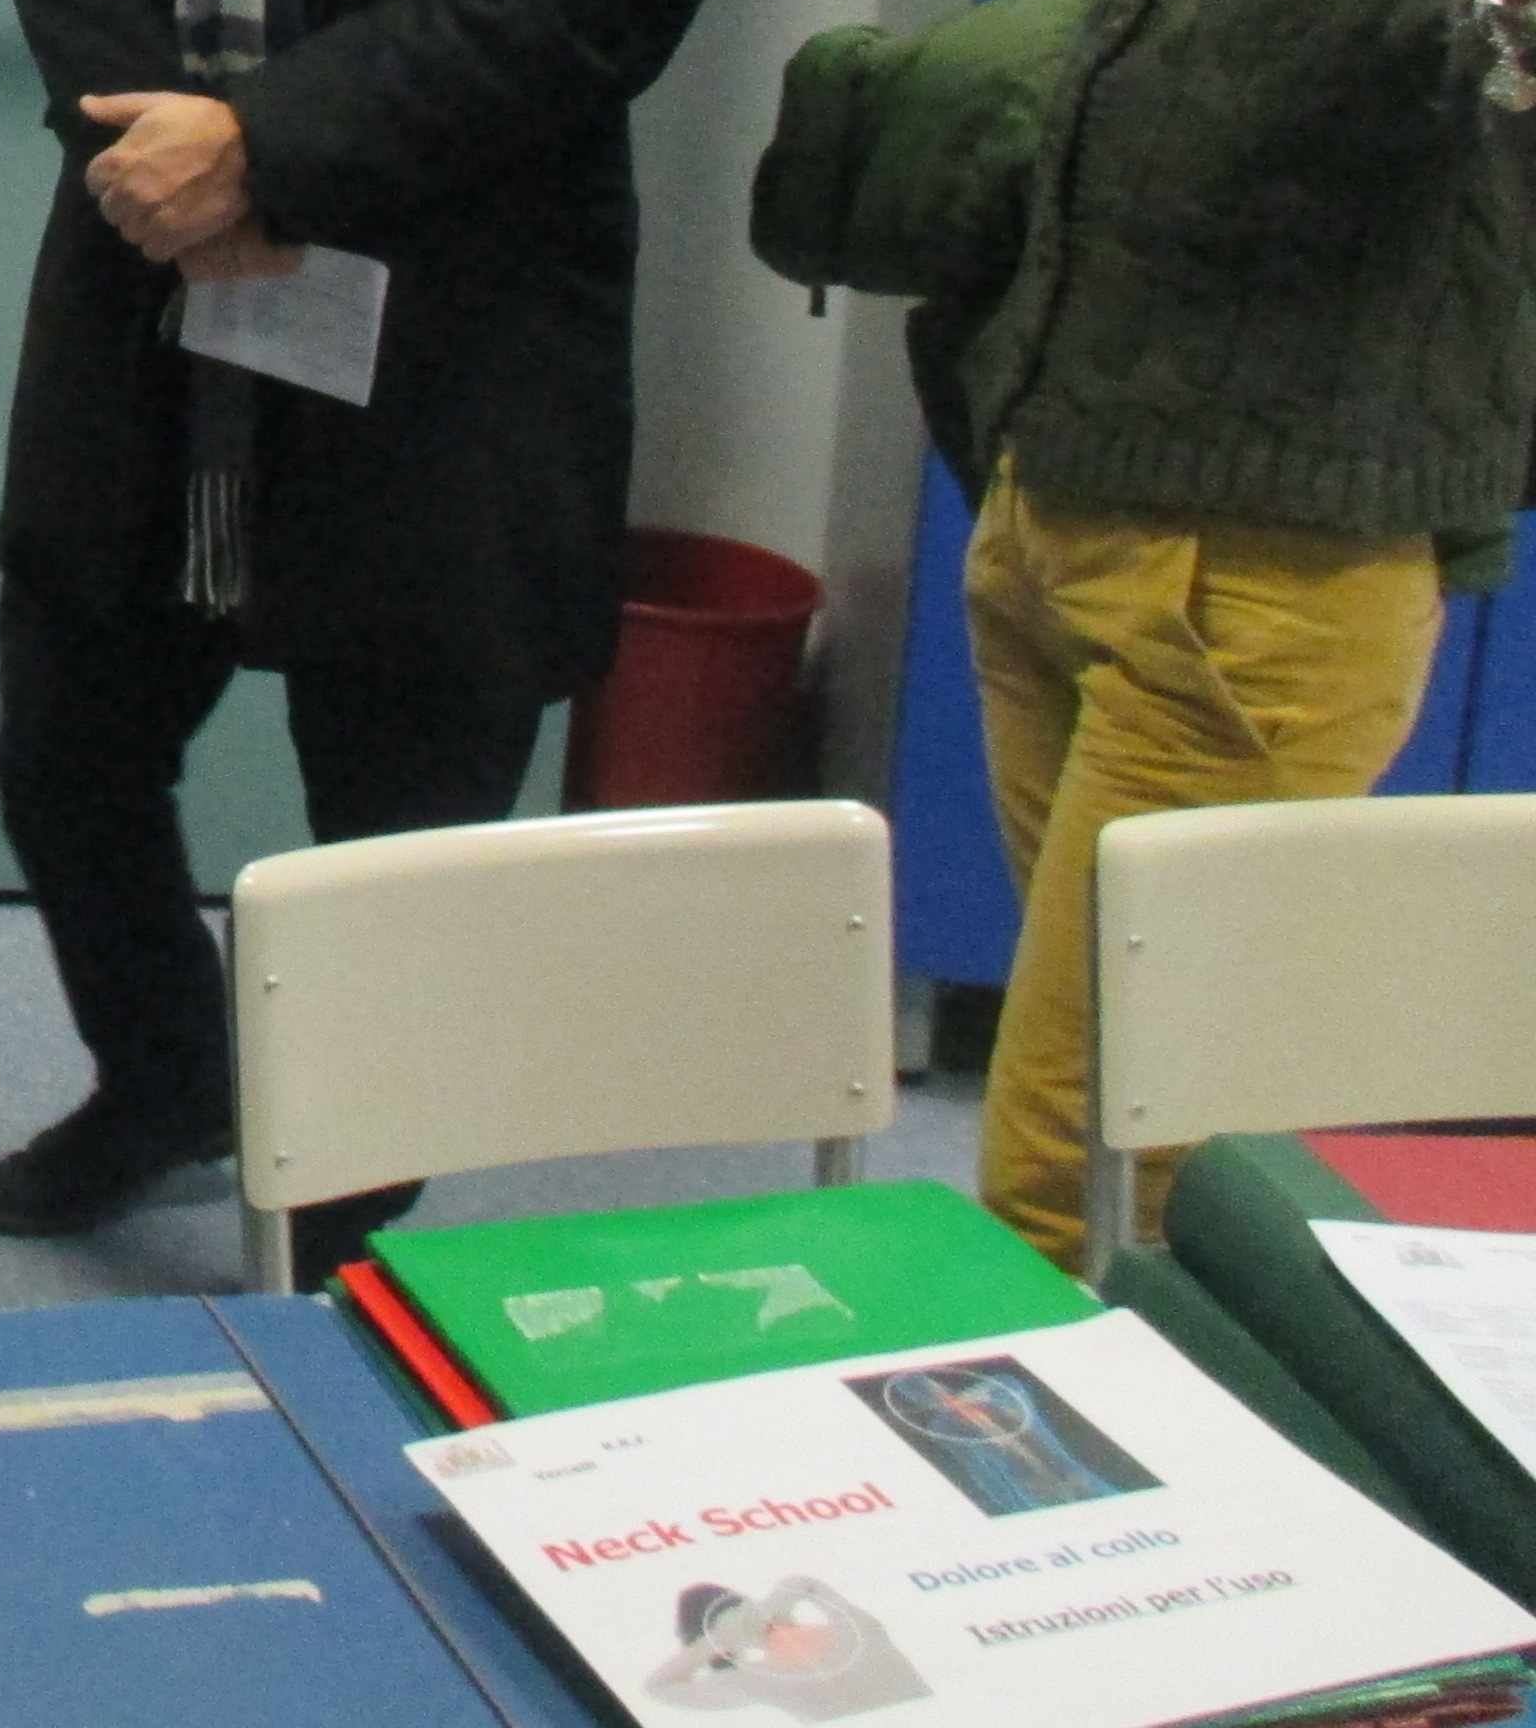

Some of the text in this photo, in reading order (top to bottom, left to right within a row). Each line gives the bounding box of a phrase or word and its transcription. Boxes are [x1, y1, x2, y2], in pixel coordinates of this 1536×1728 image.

[541, 1480, 895, 1572] Neck School
[908, 1527, 1180, 1592] Dolore al collo
[964, 1595, 1143, 1646] Istruzioni
[1144, 1585, 1202, 1614] per
